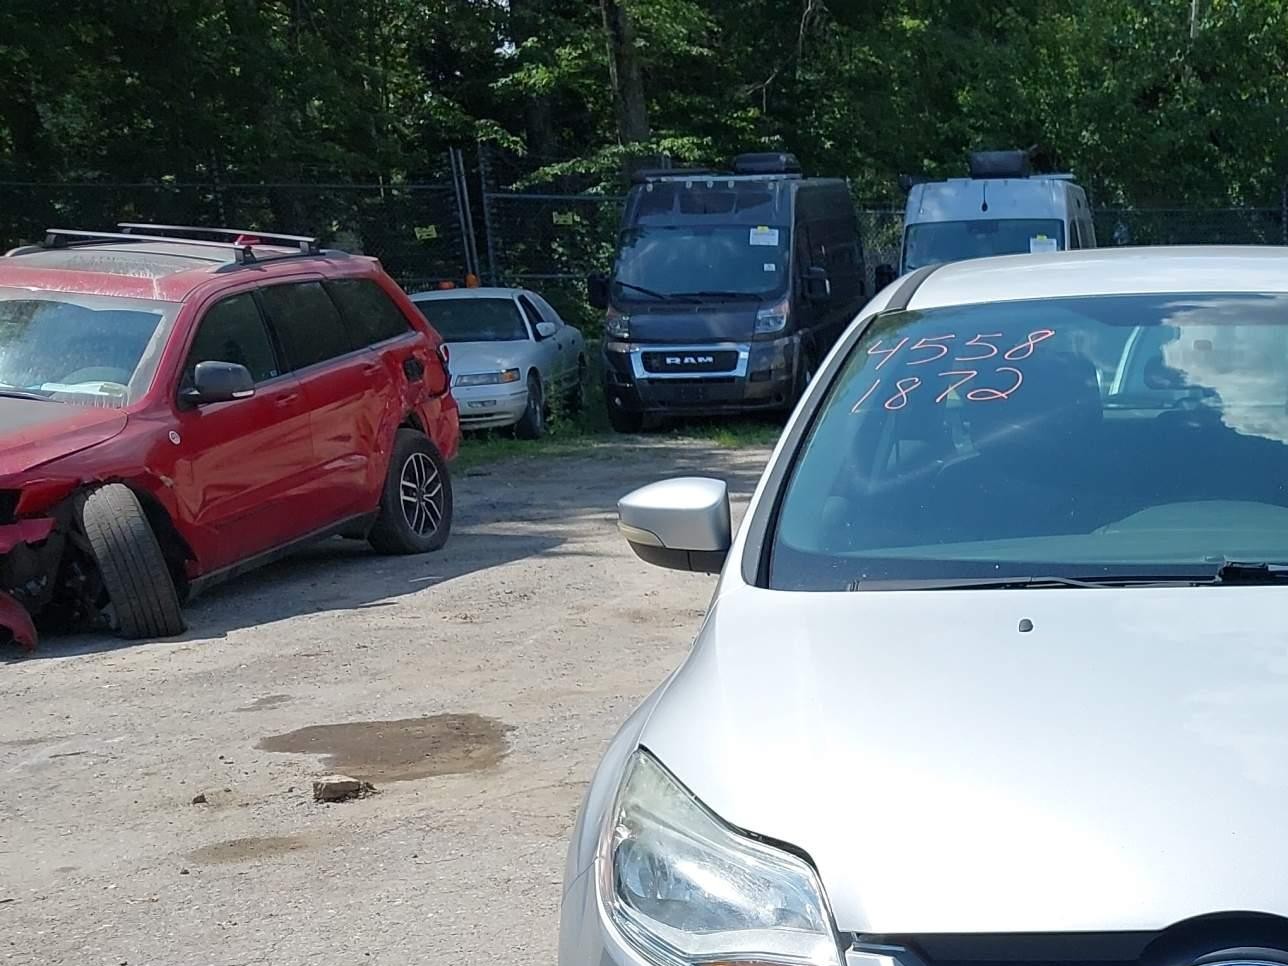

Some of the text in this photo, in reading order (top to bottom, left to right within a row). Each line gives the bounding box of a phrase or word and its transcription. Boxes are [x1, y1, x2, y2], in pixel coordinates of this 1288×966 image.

[665, 356, 714, 365] RAM
[867, 329, 1056, 371] 4558
[850, 366, 1024, 415] 1872
